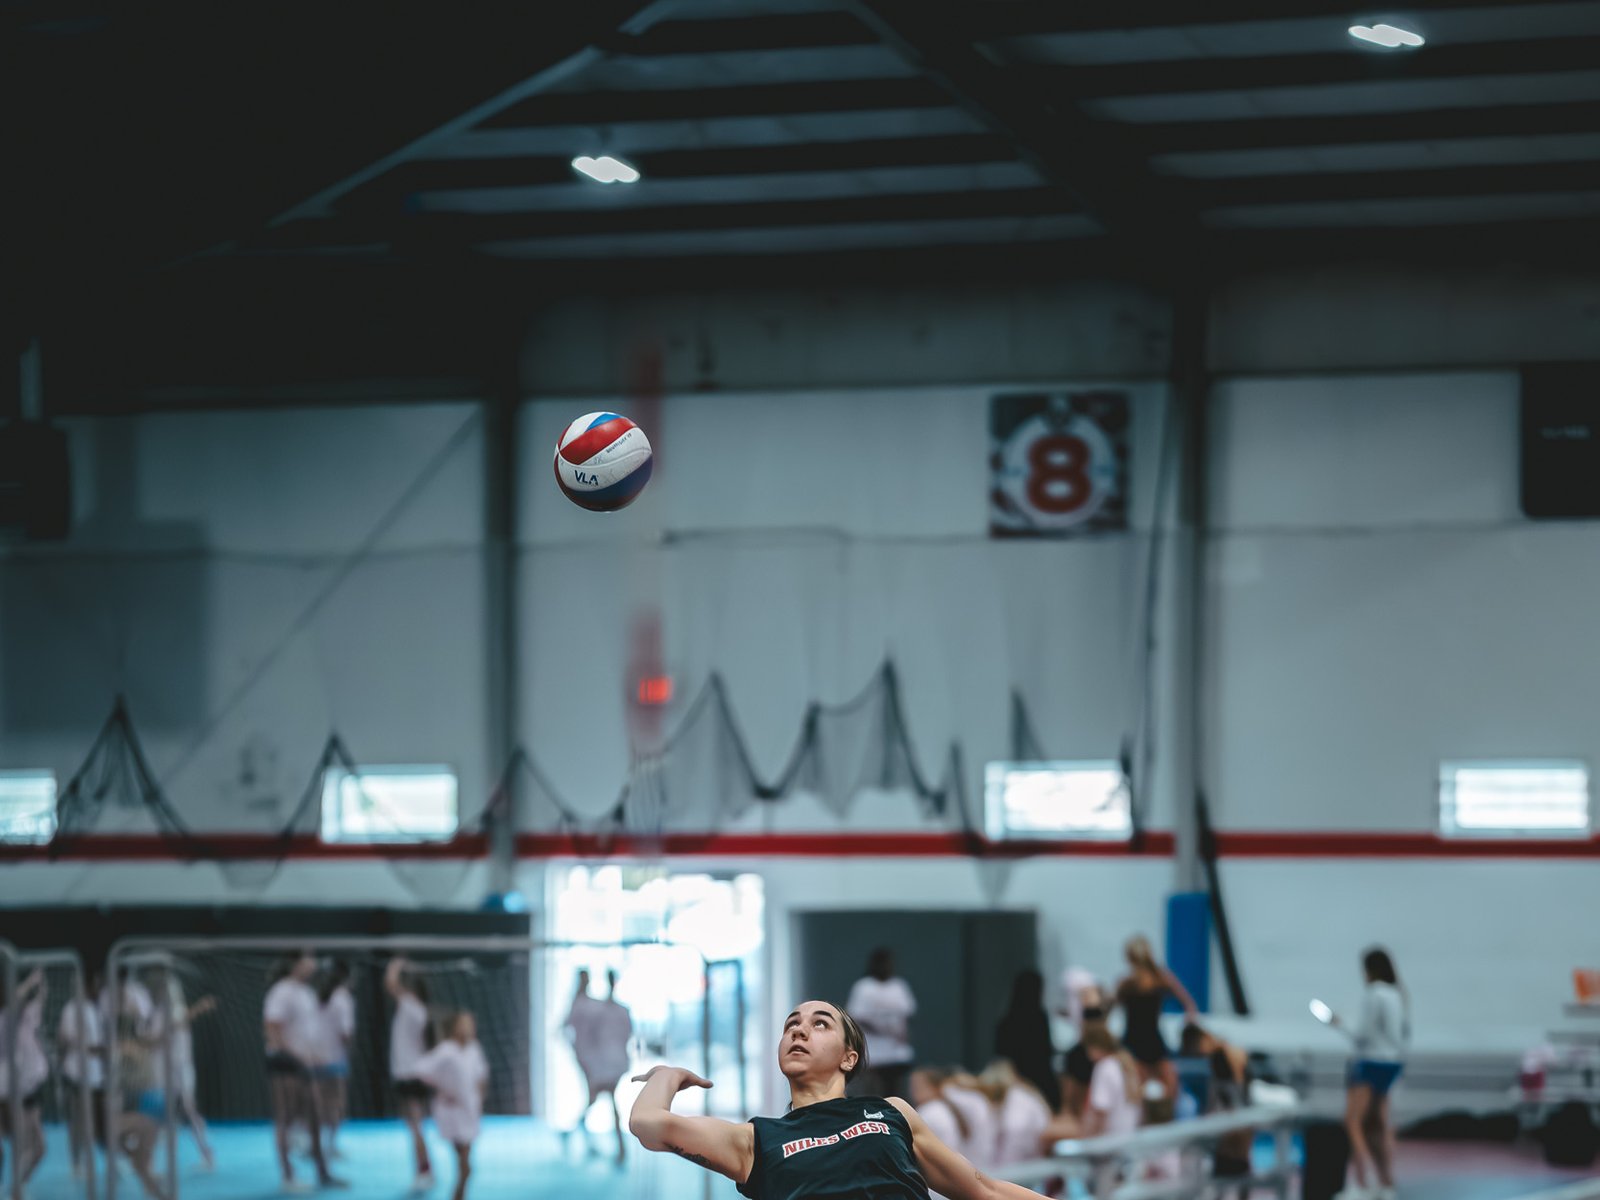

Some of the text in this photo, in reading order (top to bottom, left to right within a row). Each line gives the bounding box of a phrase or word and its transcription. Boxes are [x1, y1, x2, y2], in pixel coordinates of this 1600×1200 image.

[574, 469, 599, 486] VLA
[1026, 434, 1092, 514] 8
[783, 1121, 890, 1158] NILES WEST
